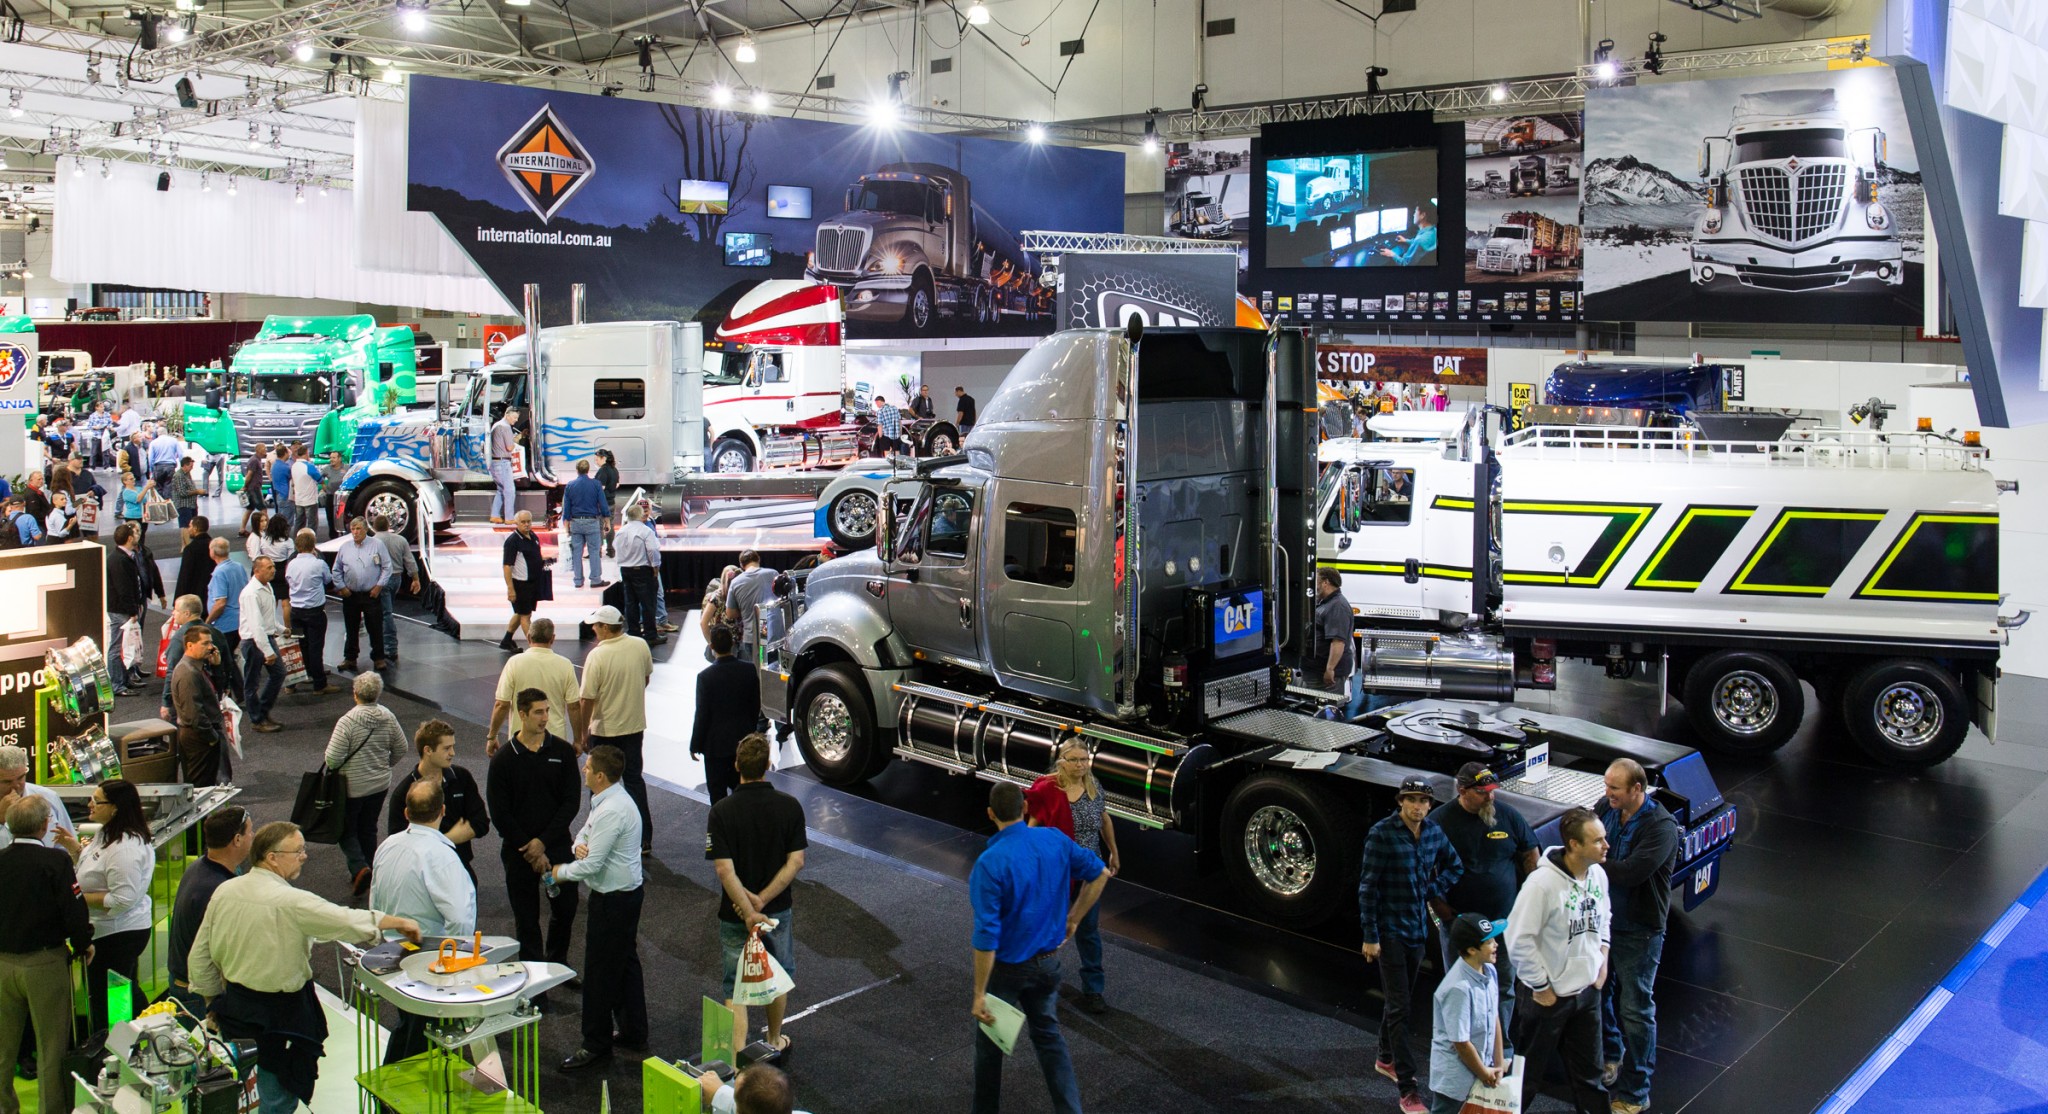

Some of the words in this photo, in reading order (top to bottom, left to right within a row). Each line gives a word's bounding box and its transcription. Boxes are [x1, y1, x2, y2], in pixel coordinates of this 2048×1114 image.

[510, 155, 583, 171] INTERNATIONAL
[477, 226, 612, 248] international.com.au
[1327, 351, 1376, 374] STOP
[1433, 355, 1461, 376] CAT
[1514, 387, 1531, 399] CAT
[1733, 369, 1742, 397] PARTS
[254, 418, 296, 427] SCANIA
[1224, 602, 1254, 634] CAT
[1527, 752, 1547, 768] JOST
[1694, 861, 1713, 895] CAT
